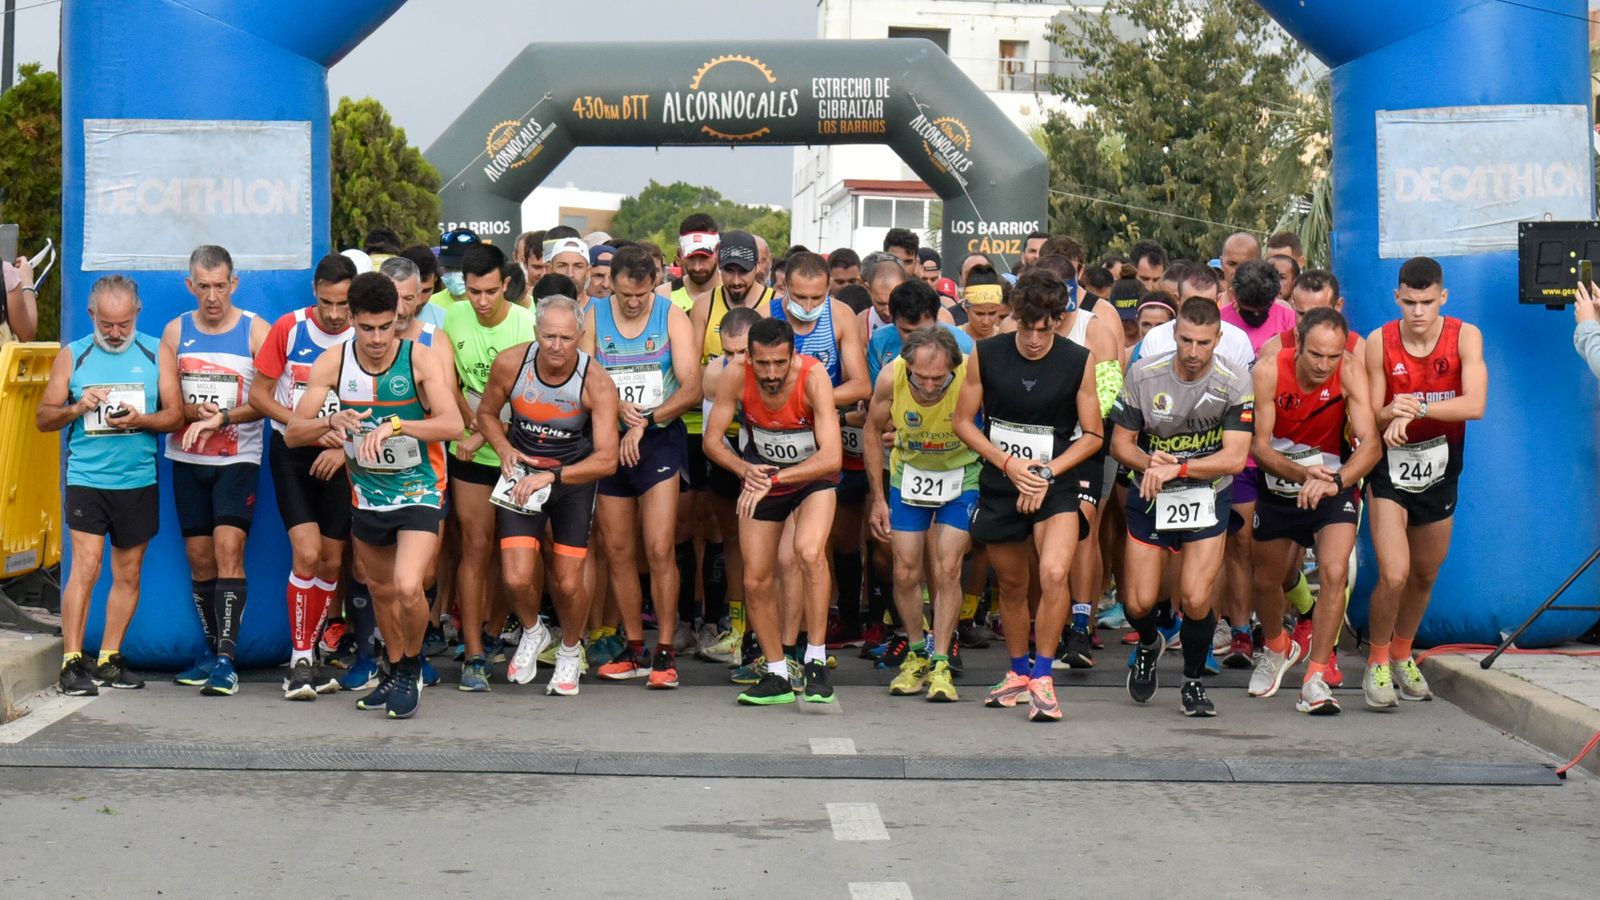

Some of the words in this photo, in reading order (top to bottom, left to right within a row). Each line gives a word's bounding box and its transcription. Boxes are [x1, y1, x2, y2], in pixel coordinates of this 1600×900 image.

[812, 78, 871, 98] ESTRECHO
[875, 78, 890, 98] DE
[572, 95, 620, 120] 430KM
[622, 94, 650, 121] BTT
[662, 88, 799, 124] ALCORNOCALES
[818, 99, 884, 119] GIBRALTAR
[818, 120, 837, 134] LOS
[840, 119, 886, 134] BARRIOS
[483, 117, 542, 183] ALCORNOCALES
[909, 114, 973, 173] ALCORNOCALES
[1395, 161, 1585, 203] DECATHLON
[97, 177, 298, 215] DECATHLON
[951, 219, 975, 234] LOS
[978, 220, 1039, 236] BARRIOS
[968, 236, 1021, 255] CÁDIZ
[520, 421, 572, 439] SANCHEZ
[764, 443, 798, 459] 500
[1399, 462, 1433, 481] 244
[911, 475, 944, 496] 321
[1166, 502, 1201, 524] 297
